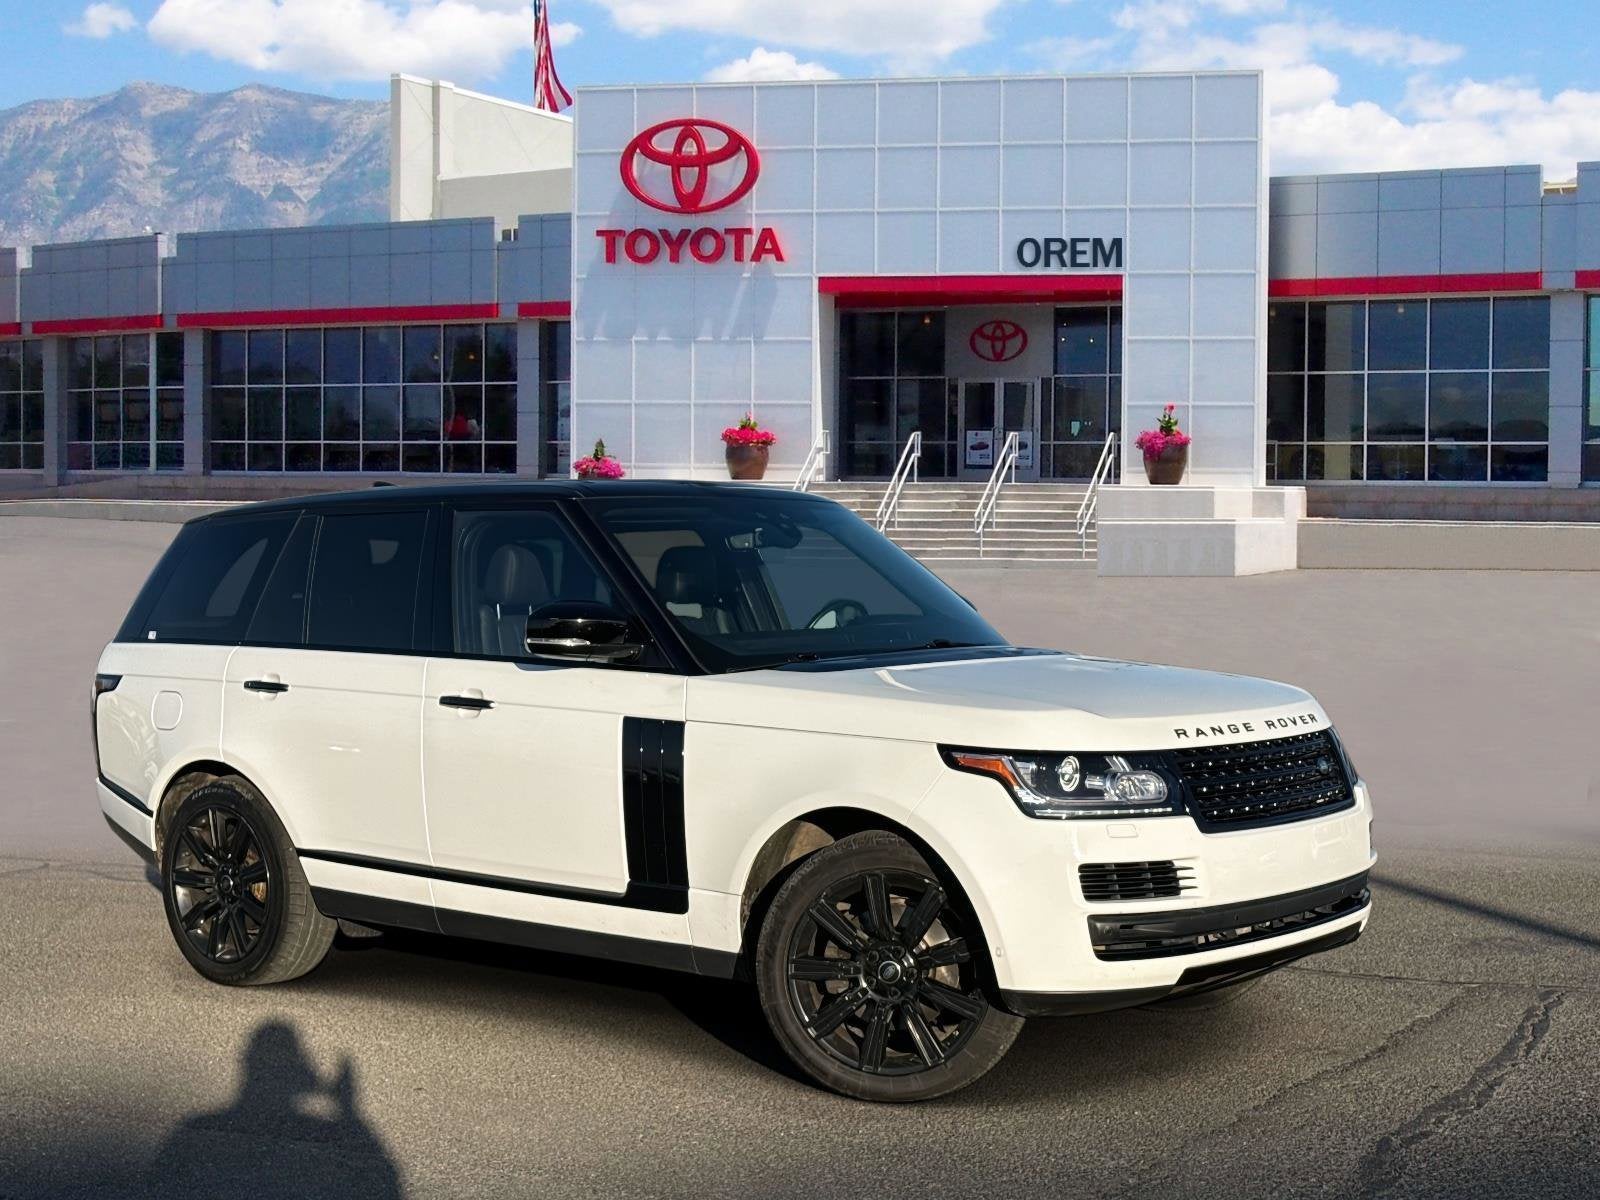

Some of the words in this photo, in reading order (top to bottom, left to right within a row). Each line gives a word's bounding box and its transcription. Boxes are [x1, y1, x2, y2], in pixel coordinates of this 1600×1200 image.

[596, 227, 784, 264] TOYOTA
[1016, 237, 1123, 268] OREM
[1174, 722, 1255, 739] RANGE
[1264, 713, 1319, 730] ROVER
